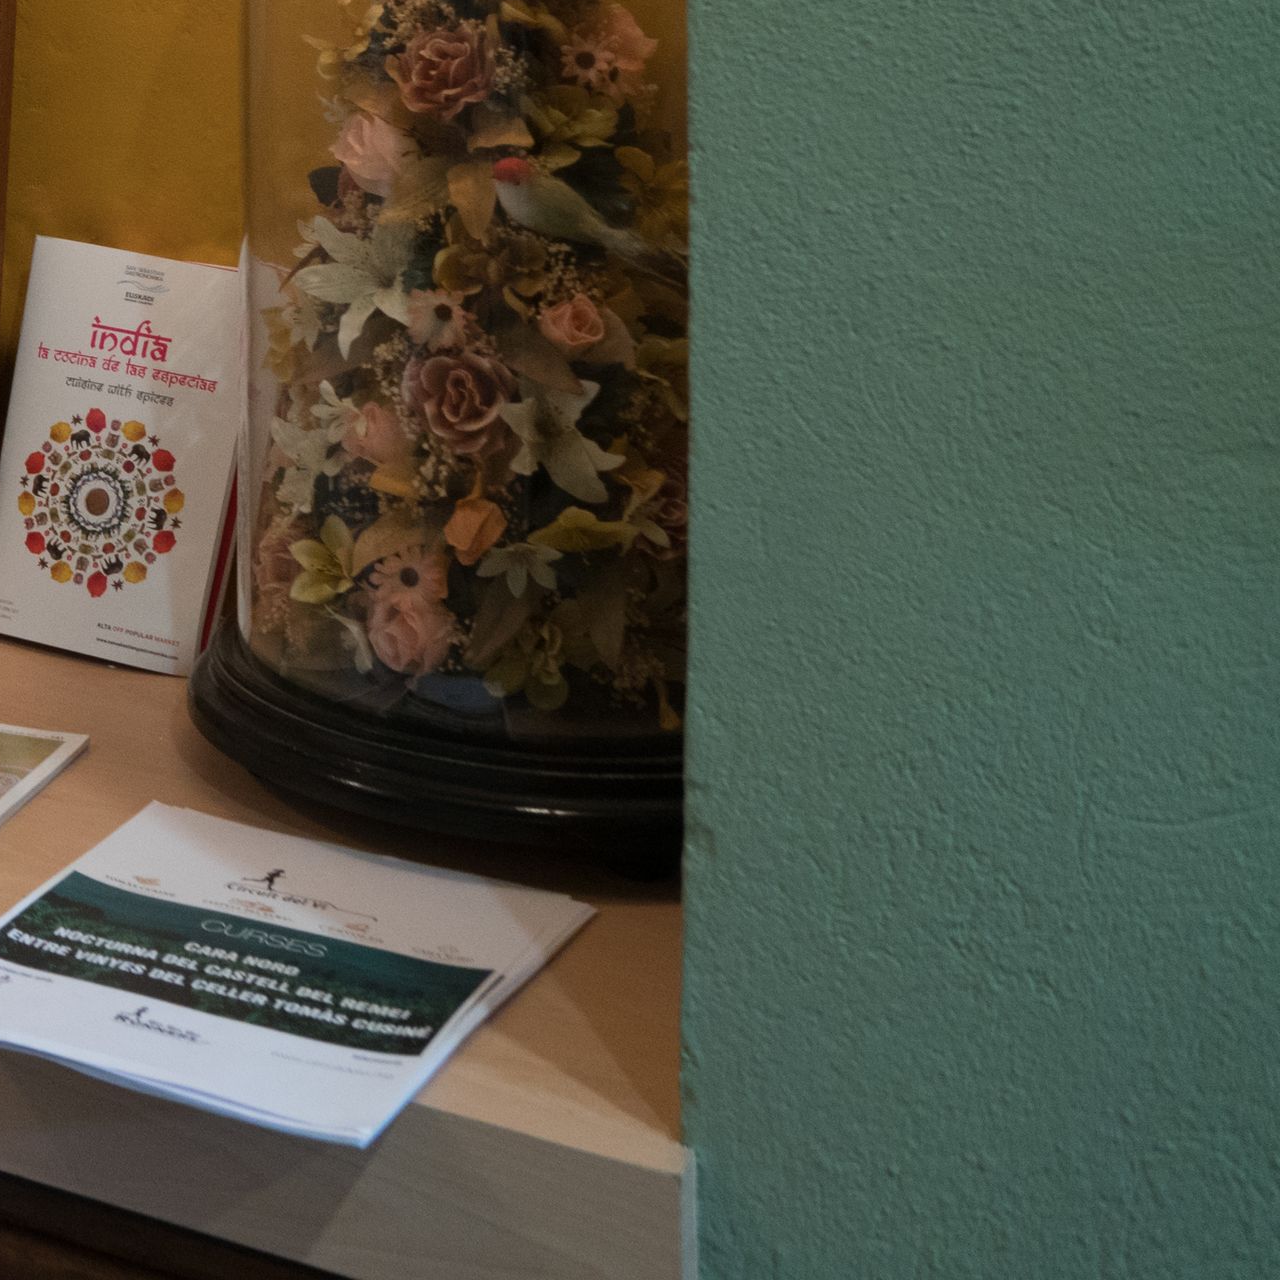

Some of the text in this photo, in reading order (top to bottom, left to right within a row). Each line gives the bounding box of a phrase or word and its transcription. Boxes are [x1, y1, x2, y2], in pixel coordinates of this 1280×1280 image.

[90, 316, 173, 363] india
[38, 342, 218, 393] la cocina de las especias
[66, 376, 175, 407] cuisine with spices
[183, 941, 300, 978] CARA NORD
[201, 919, 328, 958] CURSES
[6, 928, 72, 957] ENTRE
[74, 949, 145, 977] VINYES
[148, 967, 186, 988] DEL
[191, 978, 270, 1008] CELLER
[53, 926, 412, 1022] NOCTURNA DEL CASTELL DEL REMEI
